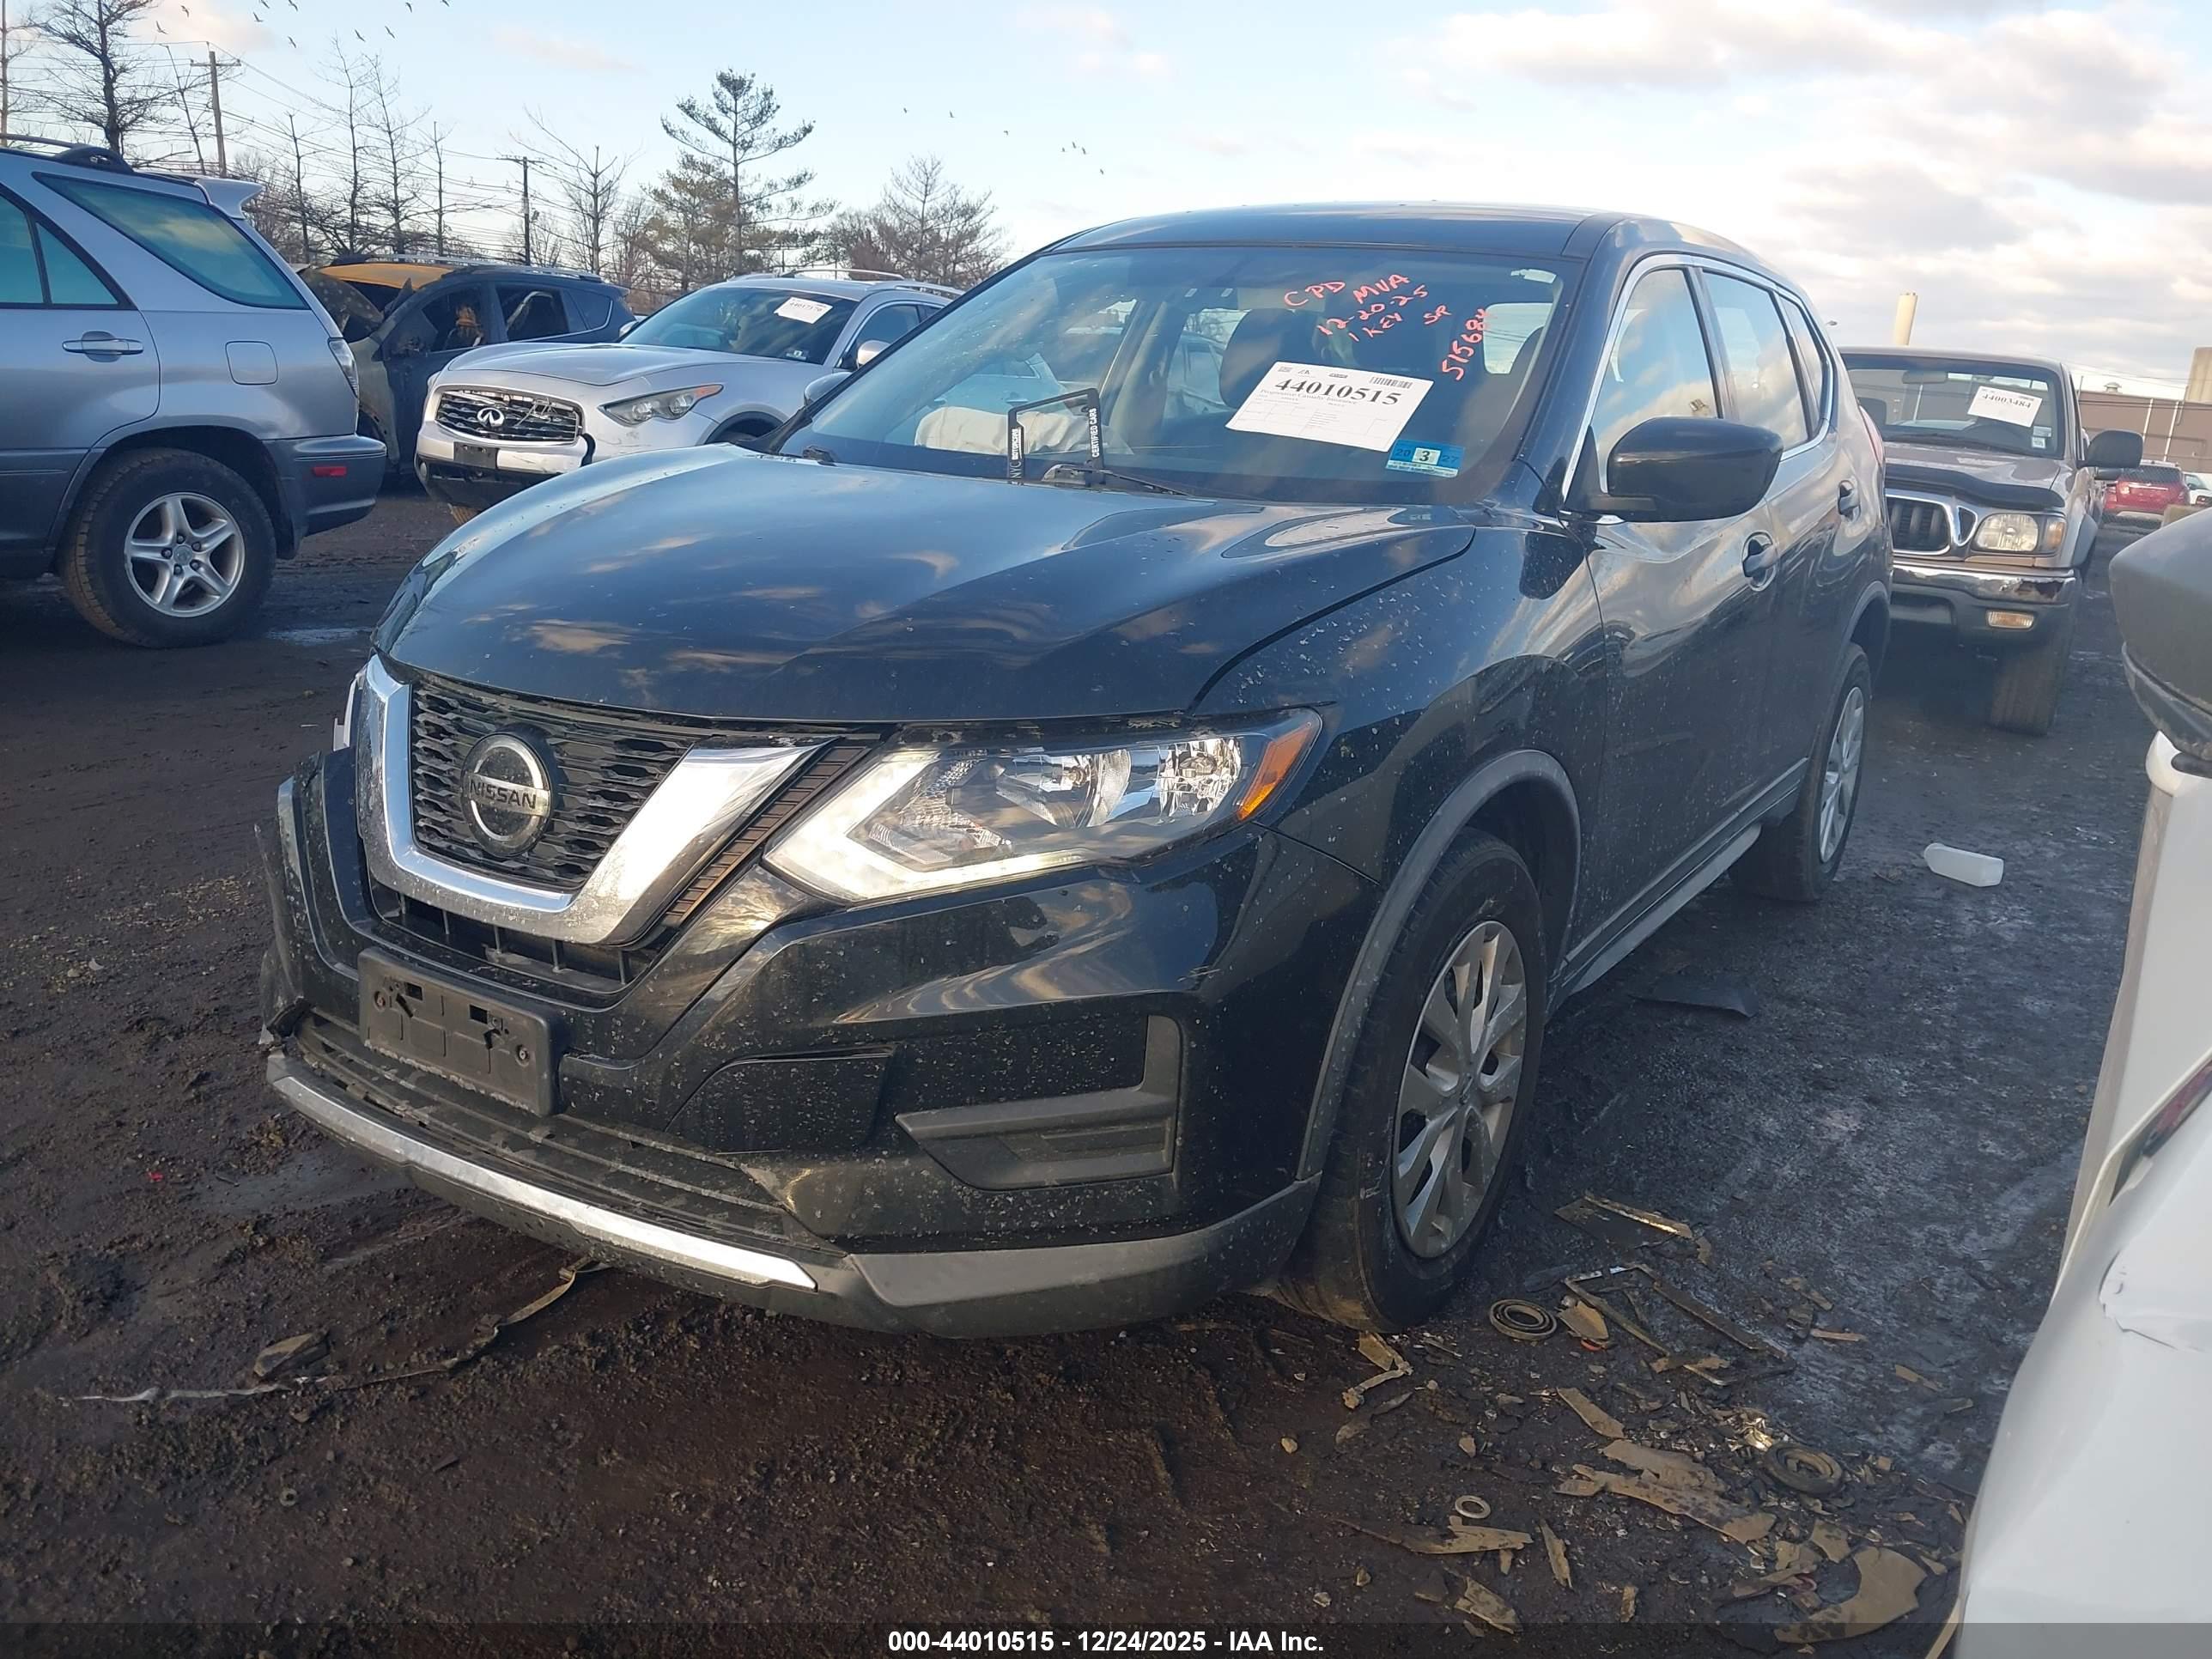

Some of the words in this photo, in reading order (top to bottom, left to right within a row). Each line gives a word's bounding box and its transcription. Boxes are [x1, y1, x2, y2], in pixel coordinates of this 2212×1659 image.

[1284, 281, 1346, 306] CPD
[1352, 274, 1411, 304] MVA
[1362, 313, 1403, 337] KEY
[1275, 379, 1401, 405] 44010515
[1982, 394, 2032, 408] 44003484
[1089, 408, 1097, 425] CARS
[1090, 425, 1099, 458] CERTIFIED
[1419, 450, 1431, 462] 3
[1010, 461, 1022, 478] NYC
[470, 778, 537, 809] NISSAN
